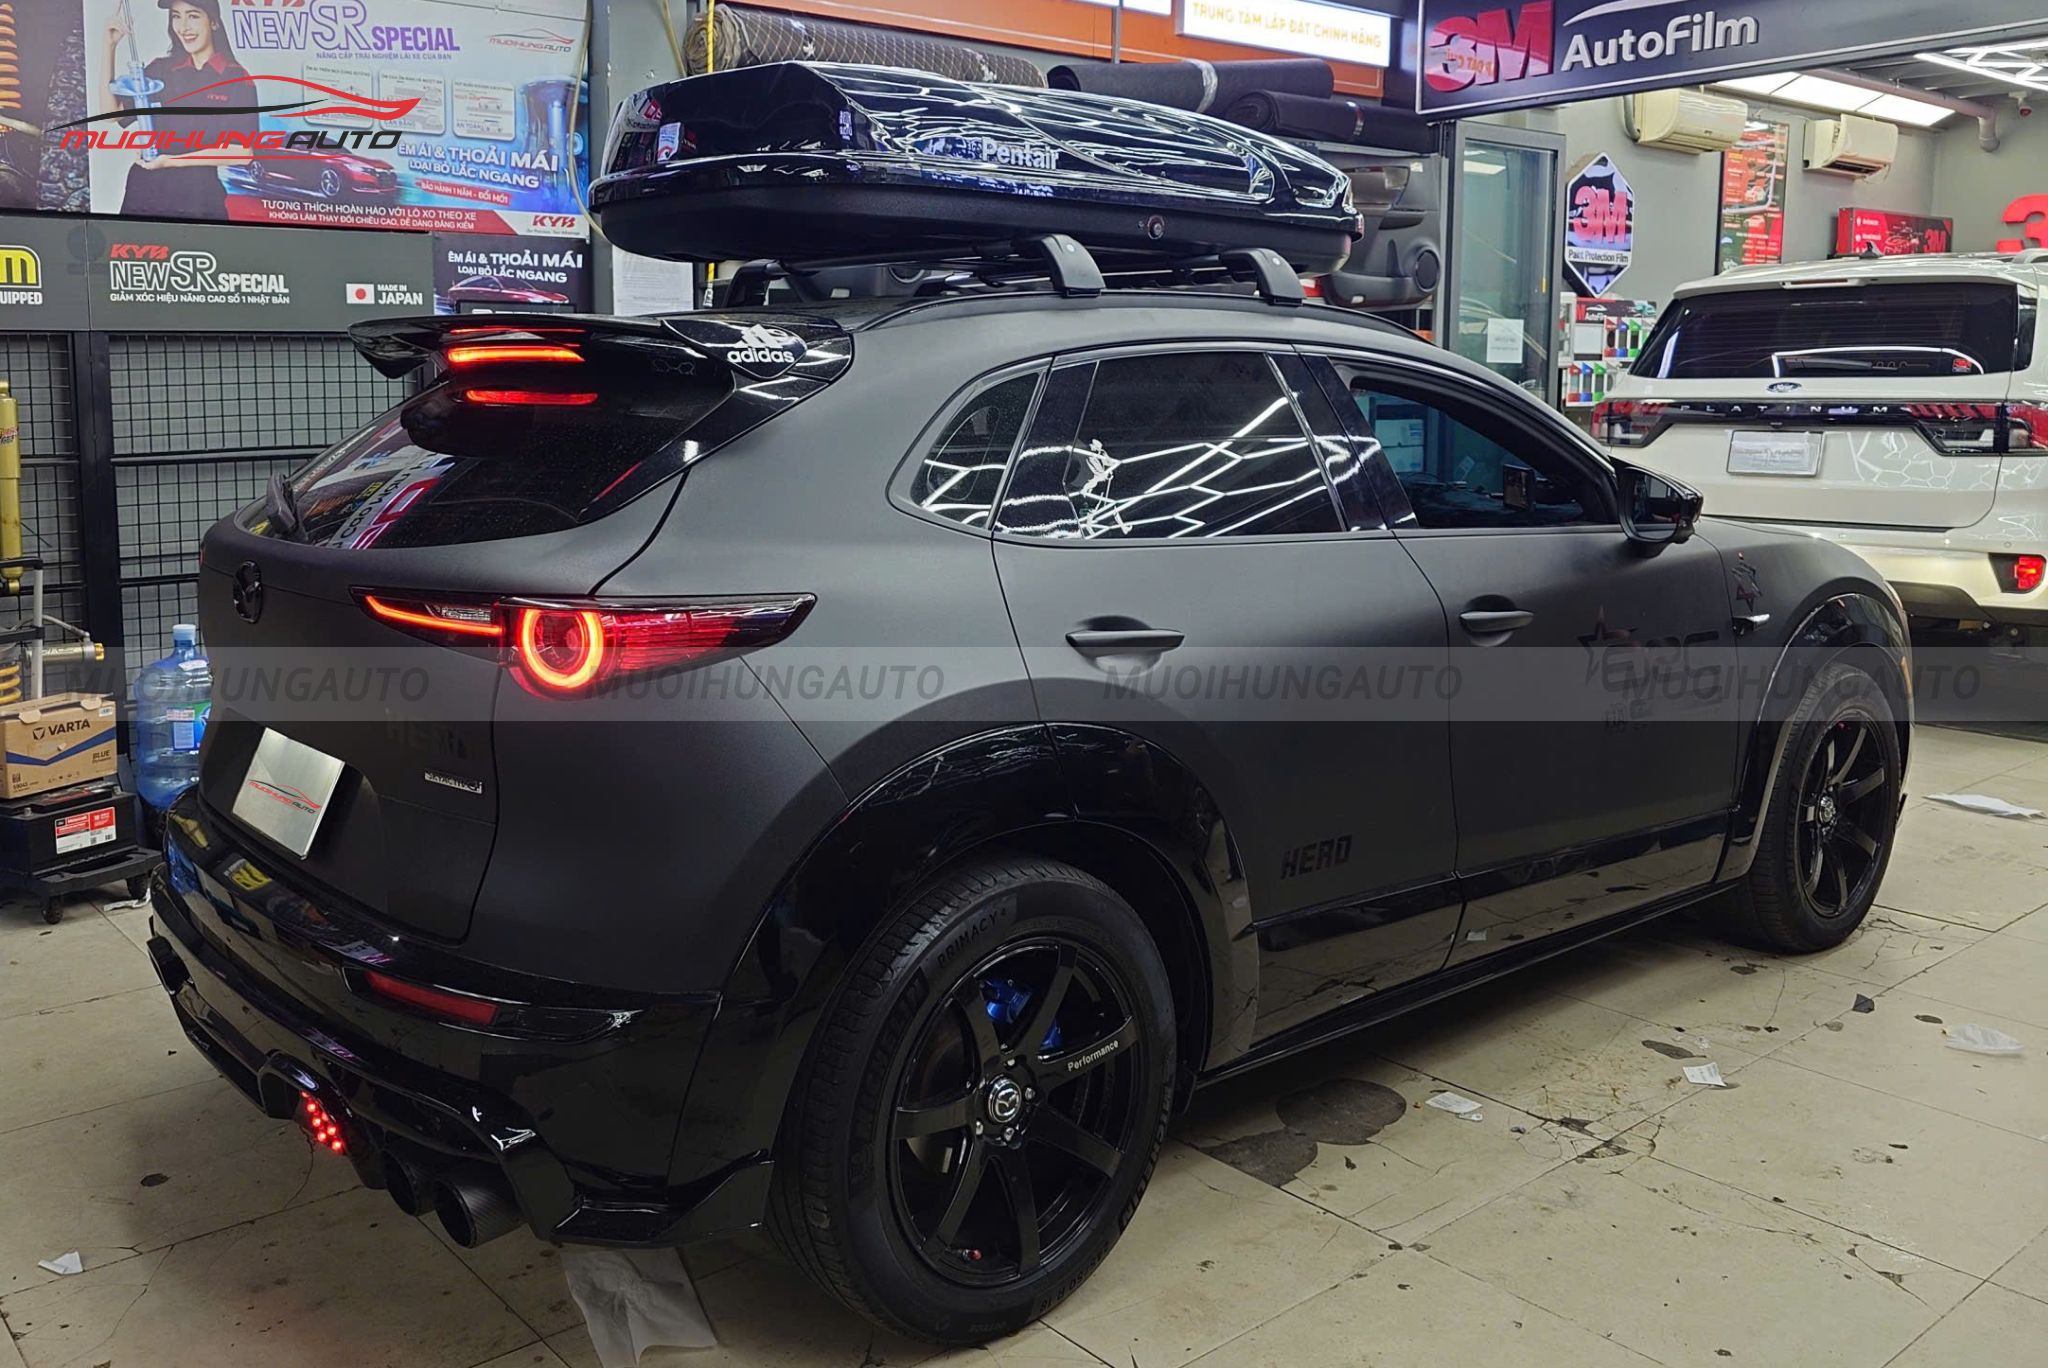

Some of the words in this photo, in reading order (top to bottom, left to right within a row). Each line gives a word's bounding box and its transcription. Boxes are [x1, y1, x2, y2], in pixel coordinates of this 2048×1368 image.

[1193, 2, 1235, 23] TRUNG
[232, 10, 308, 50] NEW
[309, 0, 372, 51] SR
[371, 26, 460, 51] SPECIAL
[1425, 0, 1555, 92] 3M
[1561, 10, 1758, 72] AutoFilm
[434, 145, 446, 159] &
[448, 145, 507, 166] THOẢI
[510, 149, 560, 172] MÁI
[981, 136, 1059, 170] Pentair
[409, 160, 432, 174] LOẠI
[433, 162, 450, 174] BỎ
[479, 169, 541, 188] NGANG
[269, 211, 299, 220] KHÔNG
[319, 214, 339, 223] THAY
[335, 204, 365, 215] HOÀN
[388, 207, 406, 217] VỚI
[422, 210, 436, 219] XO
[438, 210, 464, 220] THEO
[465, 212, 477, 221] XE
[532, 215, 576, 229] KYB
[1573, 185, 1629, 243] 3M
[1923, 229, 1947, 253] 3M
[110, 244, 170, 259] KYB
[447, 250, 464, 262] ÊM
[464, 251, 477, 263] ÁI
[479, 254, 488, 264] &
[490, 249, 538, 266] THOẢI
[542, 250, 583, 268] MÁI
[1616, 253, 1629, 263] Film
[110, 260, 170, 291] NEW
[170, 250, 219, 292] SR
[217, 273, 289, 293] SPECIAL
[458, 265, 478, 275] LOẠI
[493, 264, 515, 278] LẮC
[516, 271, 568, 283] NGANG
[0, 291, 43, 304] UIPPED
[377, 284, 398, 292] MADE
[110, 291, 134, 302] GIẢM
[135, 292, 154, 302] XÓC
[156, 292, 178, 304] HIỆU
[180, 292, 206, 303] NĂNG
[207, 295, 226, 303] CAO
[227, 292, 240, 303] SỐ
[247, 294, 270, 305] NHẬT
[378, 292, 423, 305] JAPAN
[727, 348, 795, 363] adidas
[1680, 404, 1888, 413] PLATINUM
[49, 718, 90, 736] VARTA
[1281, 834, 1352, 880] HERO
[937, 913, 998, 968] PRIMACY
[1068, 1040, 1119, 1073] Performance
